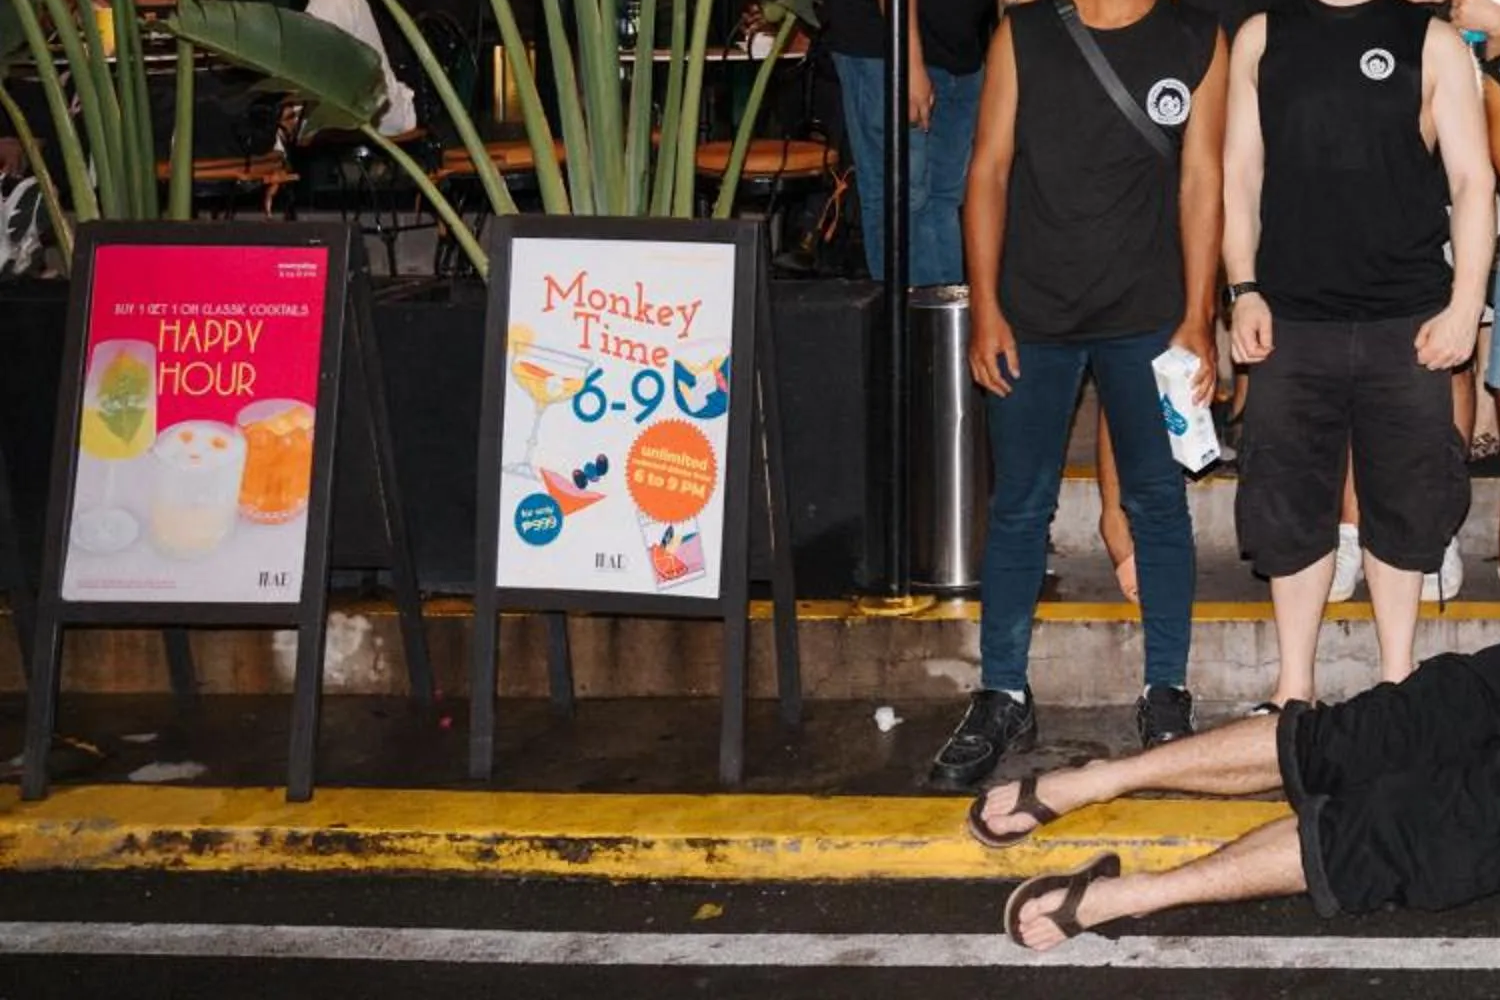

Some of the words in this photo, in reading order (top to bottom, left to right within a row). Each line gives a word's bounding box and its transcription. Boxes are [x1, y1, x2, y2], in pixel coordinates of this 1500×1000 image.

[114, 304, 133, 315] BUY
[148, 304, 168, 315] GET
[202, 304, 246, 316] CLASSIC
[251, 304, 309, 316] COCKTAILS
[542, 270, 702, 339] Monkey
[158, 319, 263, 354] HAPPY
[573, 311, 669, 368] Time
[158, 361, 257, 396] HOUR
[573, 368, 665, 424] 6-9
[640, 446, 708, 472] unlimited
[648, 473, 665, 487] to
[681, 480, 706, 499] PM
